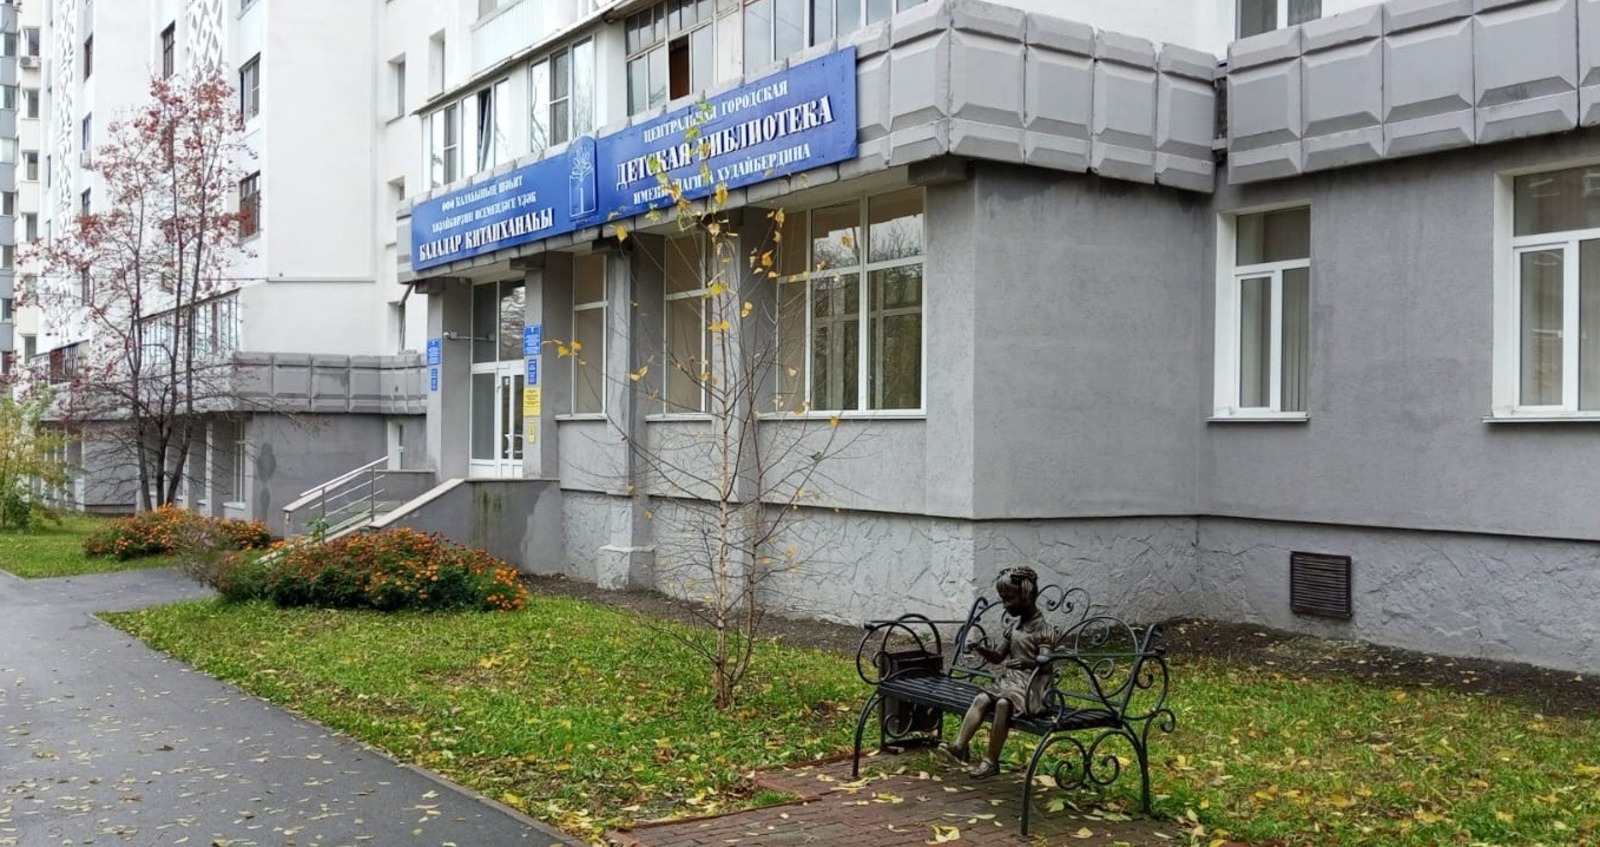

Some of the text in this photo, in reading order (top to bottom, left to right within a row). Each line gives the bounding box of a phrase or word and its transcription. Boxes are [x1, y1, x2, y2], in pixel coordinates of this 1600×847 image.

[721, 80, 788, 116] ГОРОДСКАЯ
[616, 95, 834, 189] ДЕТСКАЯ БИБЛИОТЕКА
[717, 143, 811, 181] ХУДАЙБЕРДИНА
[419, 208, 553, 262] БАЛАЛАР КИТАПХАНАҺЫ
